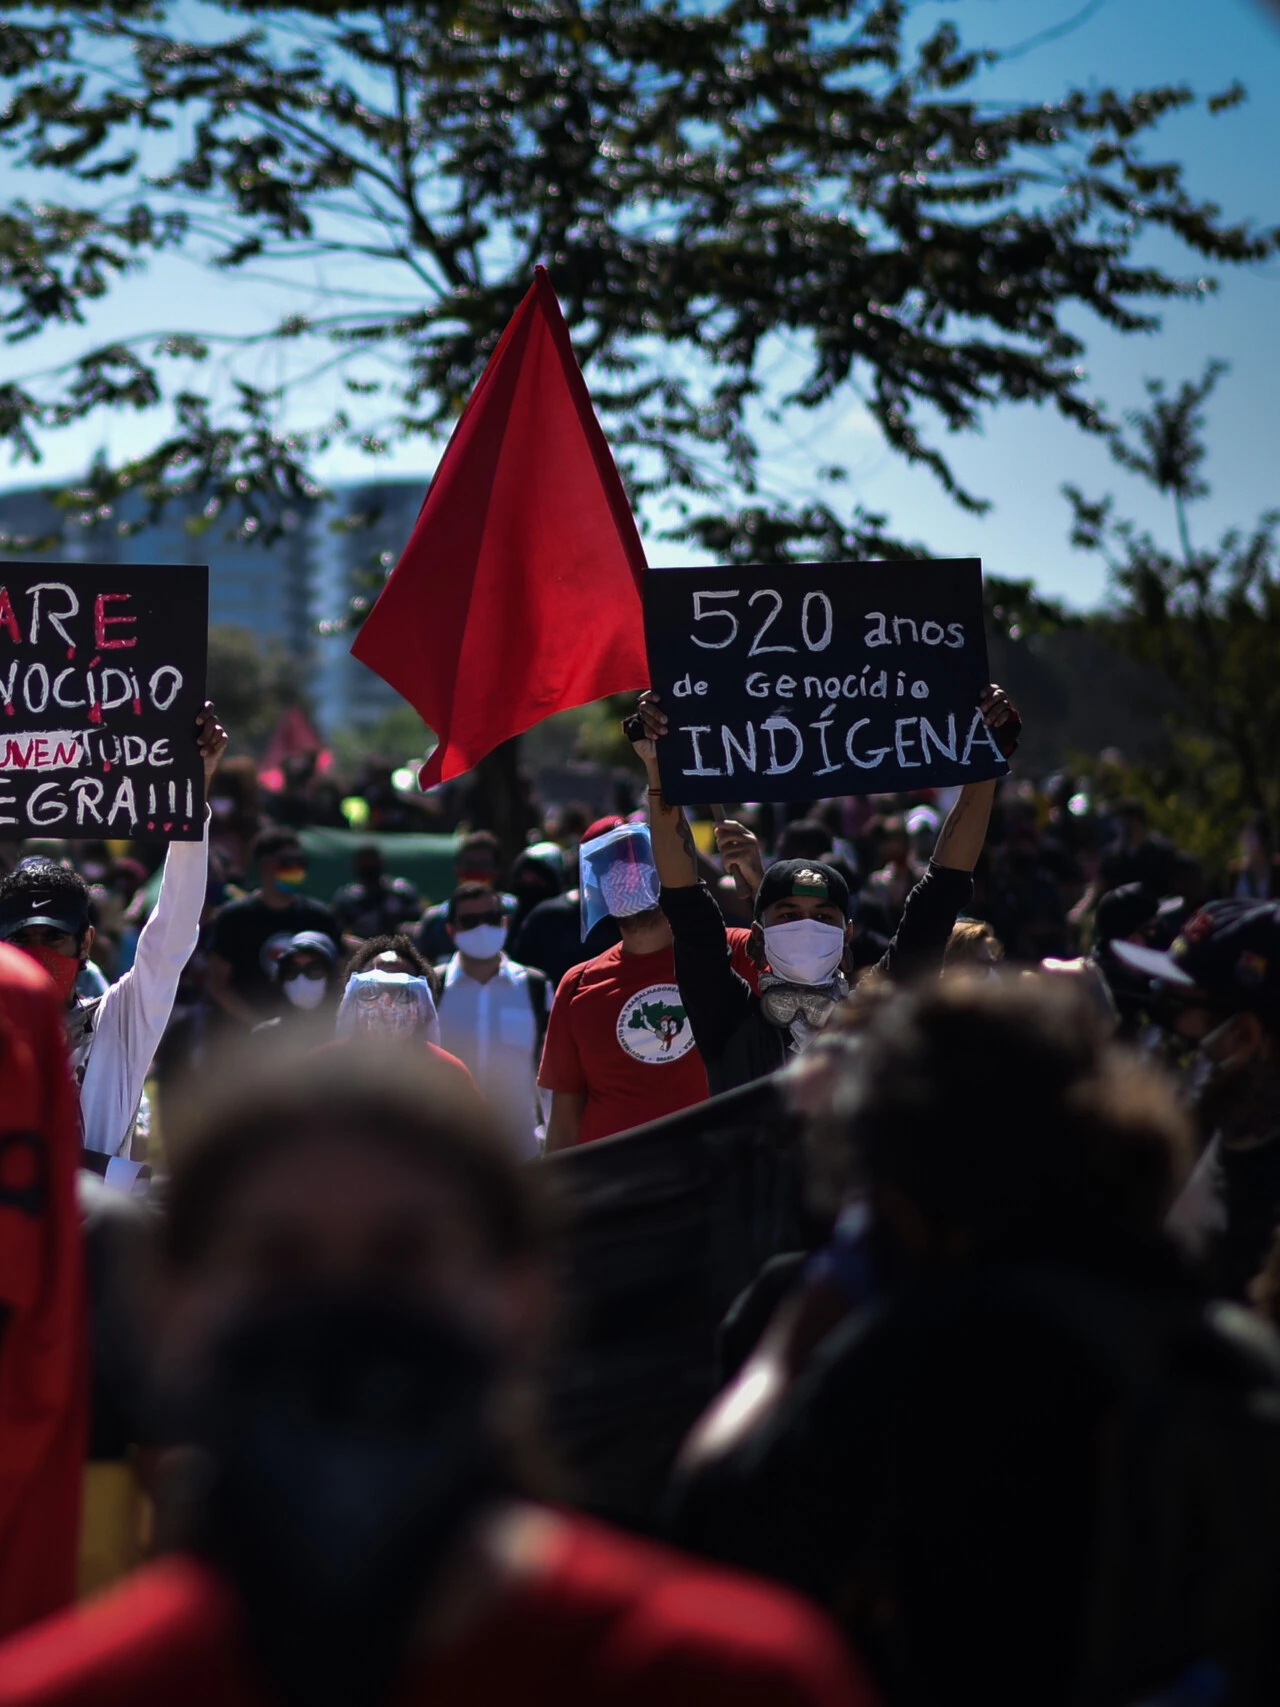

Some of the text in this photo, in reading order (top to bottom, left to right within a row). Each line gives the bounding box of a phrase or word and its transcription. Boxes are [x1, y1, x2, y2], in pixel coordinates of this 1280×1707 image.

[690, 588, 965, 657] 520 anos
[672, 672, 709, 698] de
[678, 703, 1007, 778] INDÍGENA
[618, 1014, 627, 1028] DOS
[618, 1029, 646, 1061] MOVIMENTO
